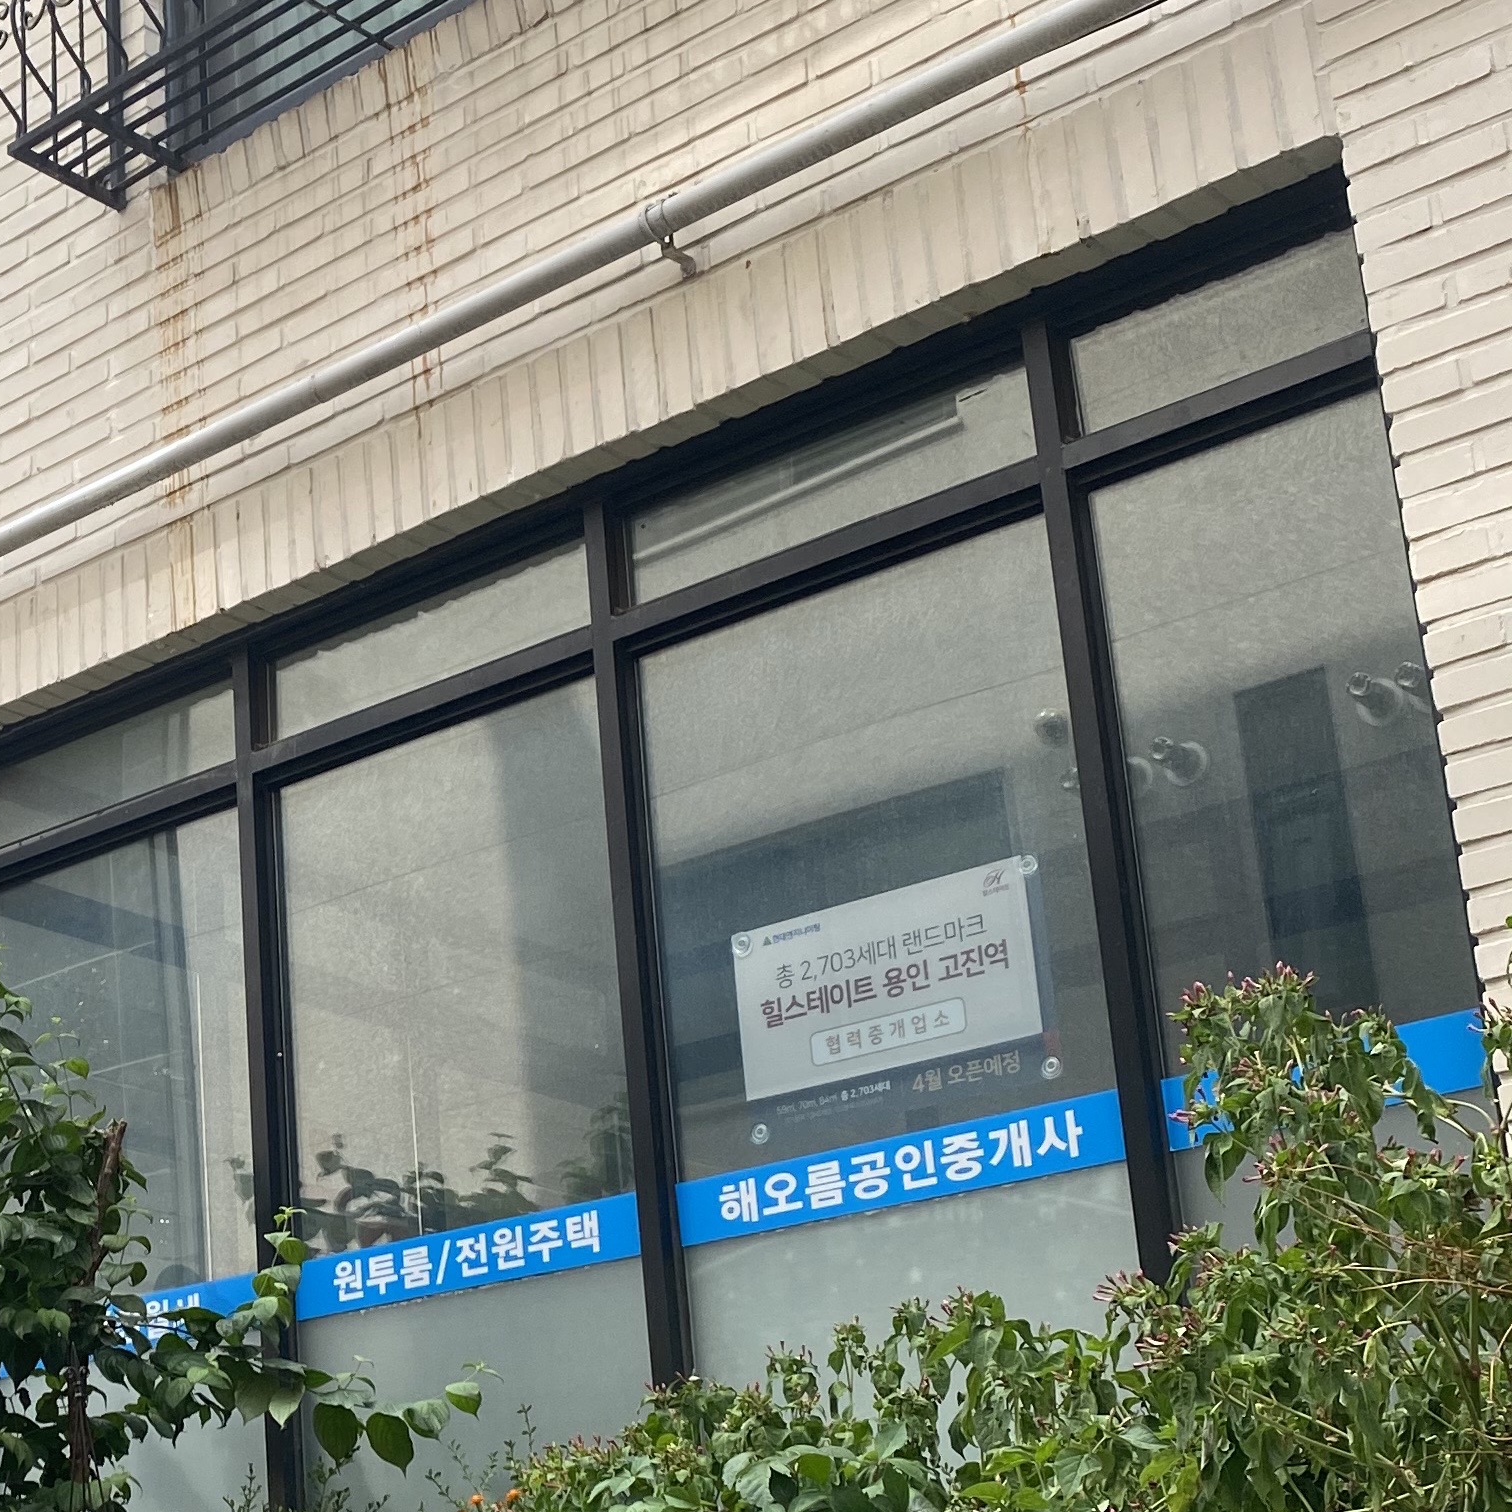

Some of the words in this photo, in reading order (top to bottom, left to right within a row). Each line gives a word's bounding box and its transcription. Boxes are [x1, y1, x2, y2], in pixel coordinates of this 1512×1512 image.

[759, 975, 878, 1029] 힐스테이트
[882, 959, 931, 998] 용인
[937, 938, 1010, 982] 고진역
[774, 963, 796, 989] 총
[800, 935, 898, 982] 2,703세대
[901, 913, 988, 955] 랜드마크
[824, 1009, 951, 1056] 협력중개업소
[912, 1069, 944, 1094] 4월
[946, 1050, 1022, 1087] 오픈예정
[718, 1109, 1085, 1225] 해오름공인중개사
[333, 1209, 604, 1302] 원투룸/전원주택
